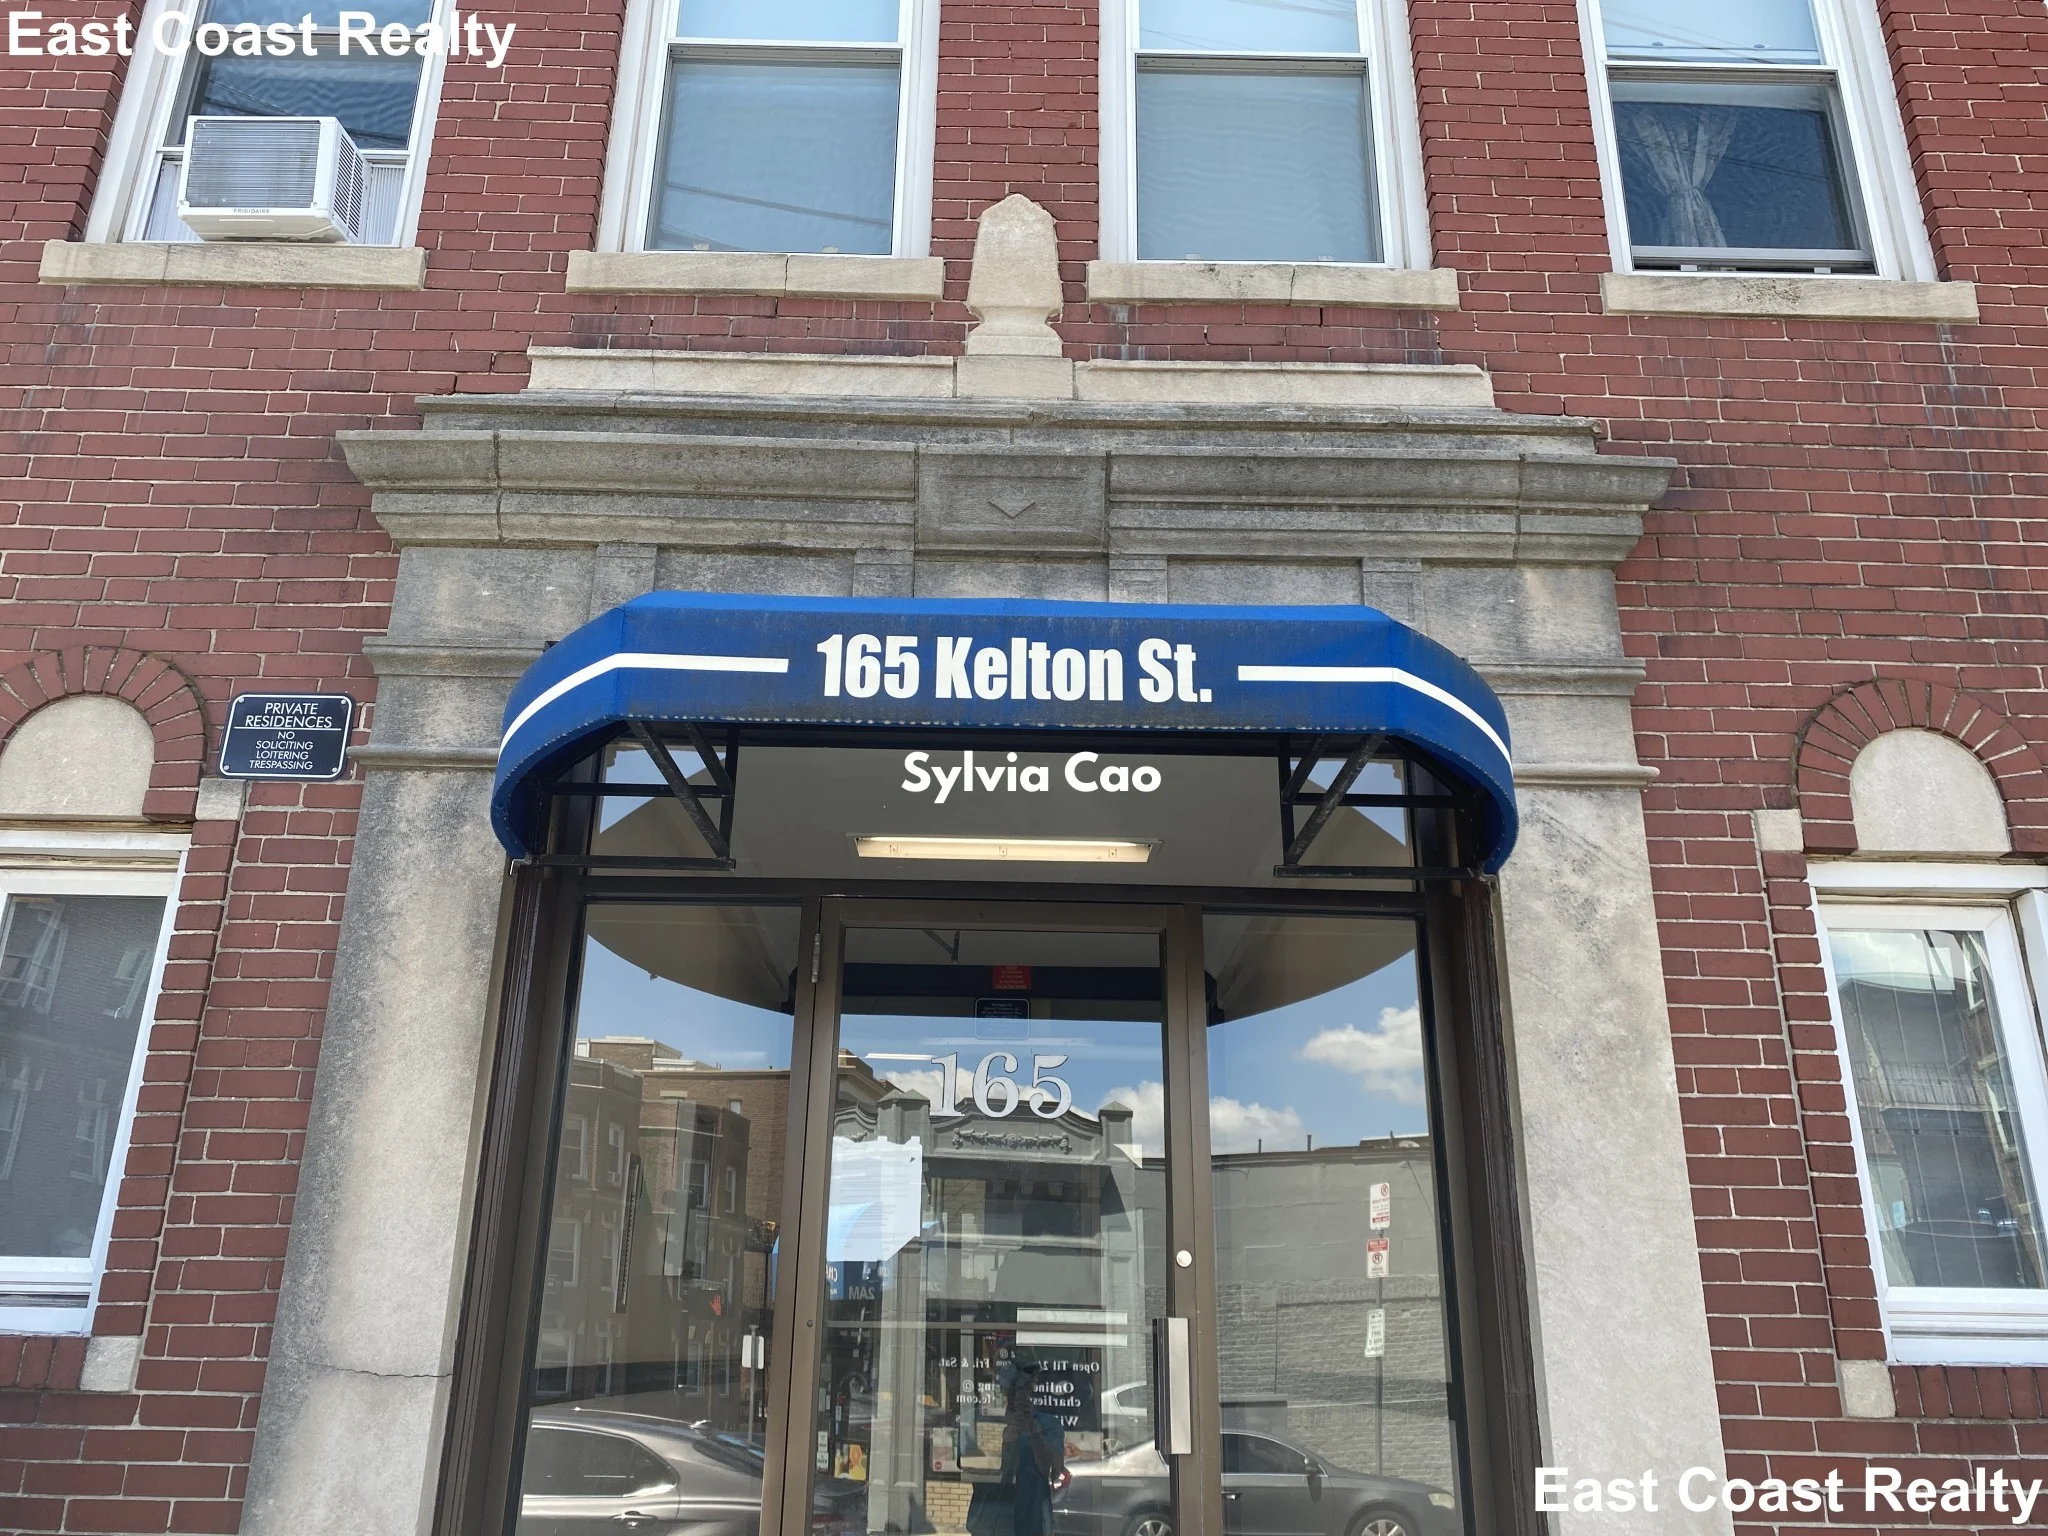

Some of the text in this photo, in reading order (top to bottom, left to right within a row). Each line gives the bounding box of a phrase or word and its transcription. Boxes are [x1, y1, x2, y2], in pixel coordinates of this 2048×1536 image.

[816, 633, 1213, 703] 165 Kelton St.
[264, 702, 319, 715] PRIVATE
[245, 715, 333, 728] RESIDENCES
[277, 731, 295, 740] NO
[255, 740, 314, 751] SOLICITING
[256, 750, 309, 760] LOITERING
[249, 760, 314, 770] TRESPASSING
[930, 1052, 1072, 1119] 165
